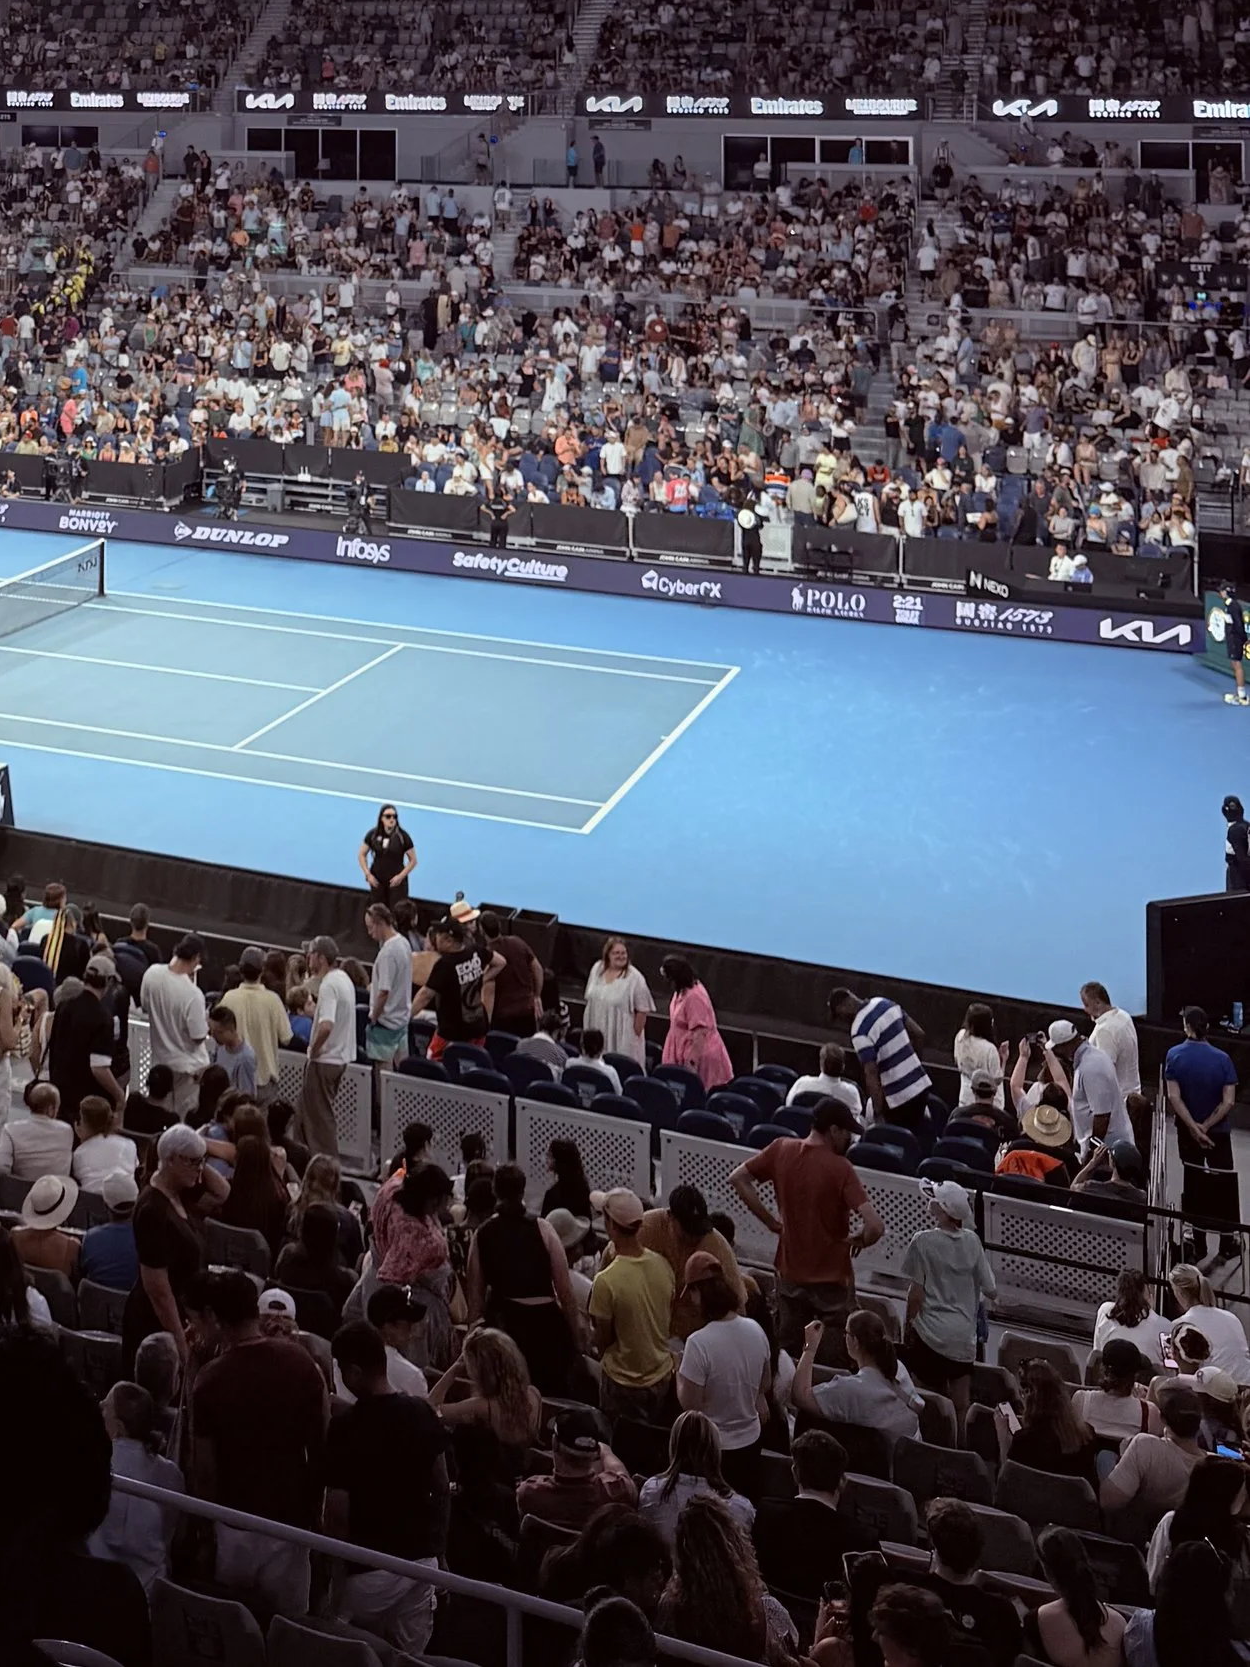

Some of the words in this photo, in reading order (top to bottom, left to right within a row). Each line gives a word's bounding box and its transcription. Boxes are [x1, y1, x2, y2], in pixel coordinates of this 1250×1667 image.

[70, 92, 124, 108] Emirates
[385, 94, 447, 111] Emirates
[751, 97, 824, 115] Emirates
[68, 508, 111, 520] MARRIOTT
[59, 515, 116, 534] BONVOY
[191, 526, 289, 547] DUNLOP
[336, 536, 391, 564] Infosys
[452, 551, 568, 581] SafetyCulture
[983, 578, 1010, 599] NEXO
[807, 588, 866, 612] POLO
[893, 595, 923, 610] 2:21
